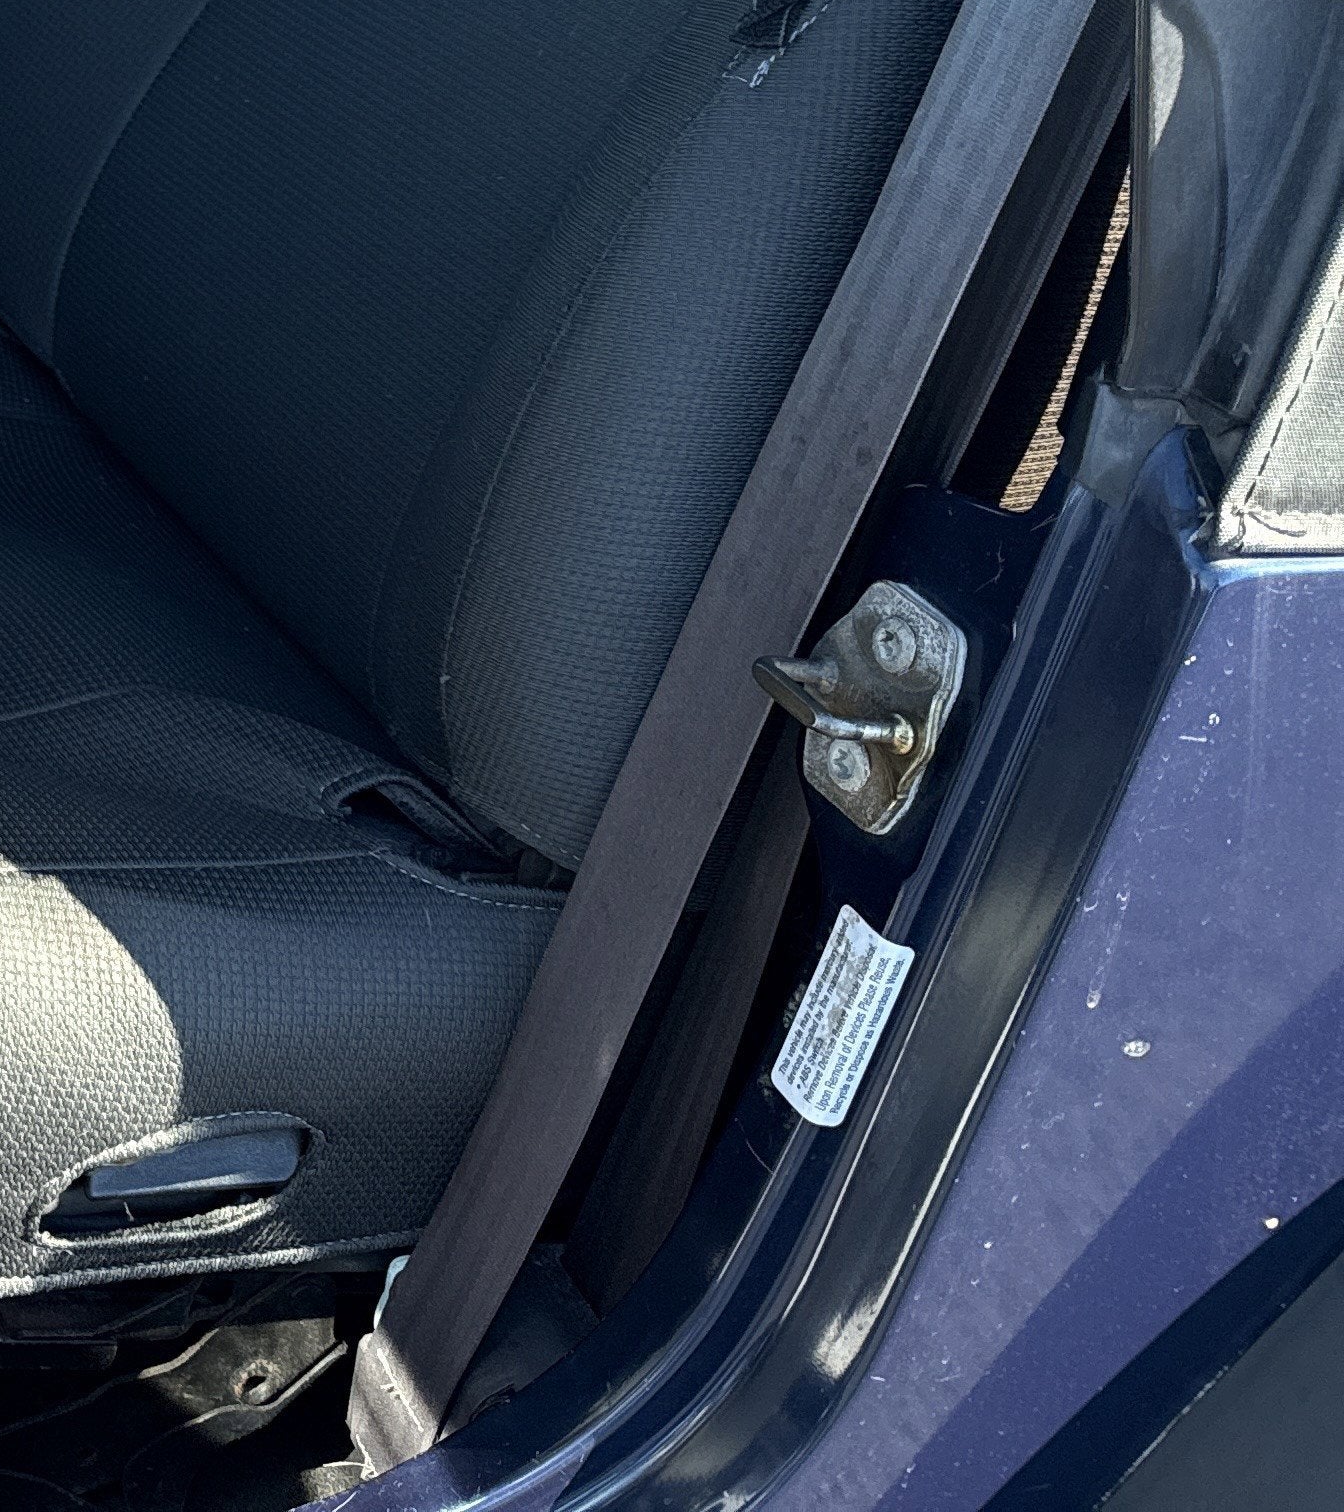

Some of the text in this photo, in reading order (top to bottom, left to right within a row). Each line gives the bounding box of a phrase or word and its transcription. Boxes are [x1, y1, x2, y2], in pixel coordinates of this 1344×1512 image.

[857, 982, 878, 1011] Please
[843, 1010, 866, 1044] Devices
[839, 1042, 853, 1054] of
[798, 1063, 811, 1086] ABS
[824, 1052, 848, 1089] Removal
